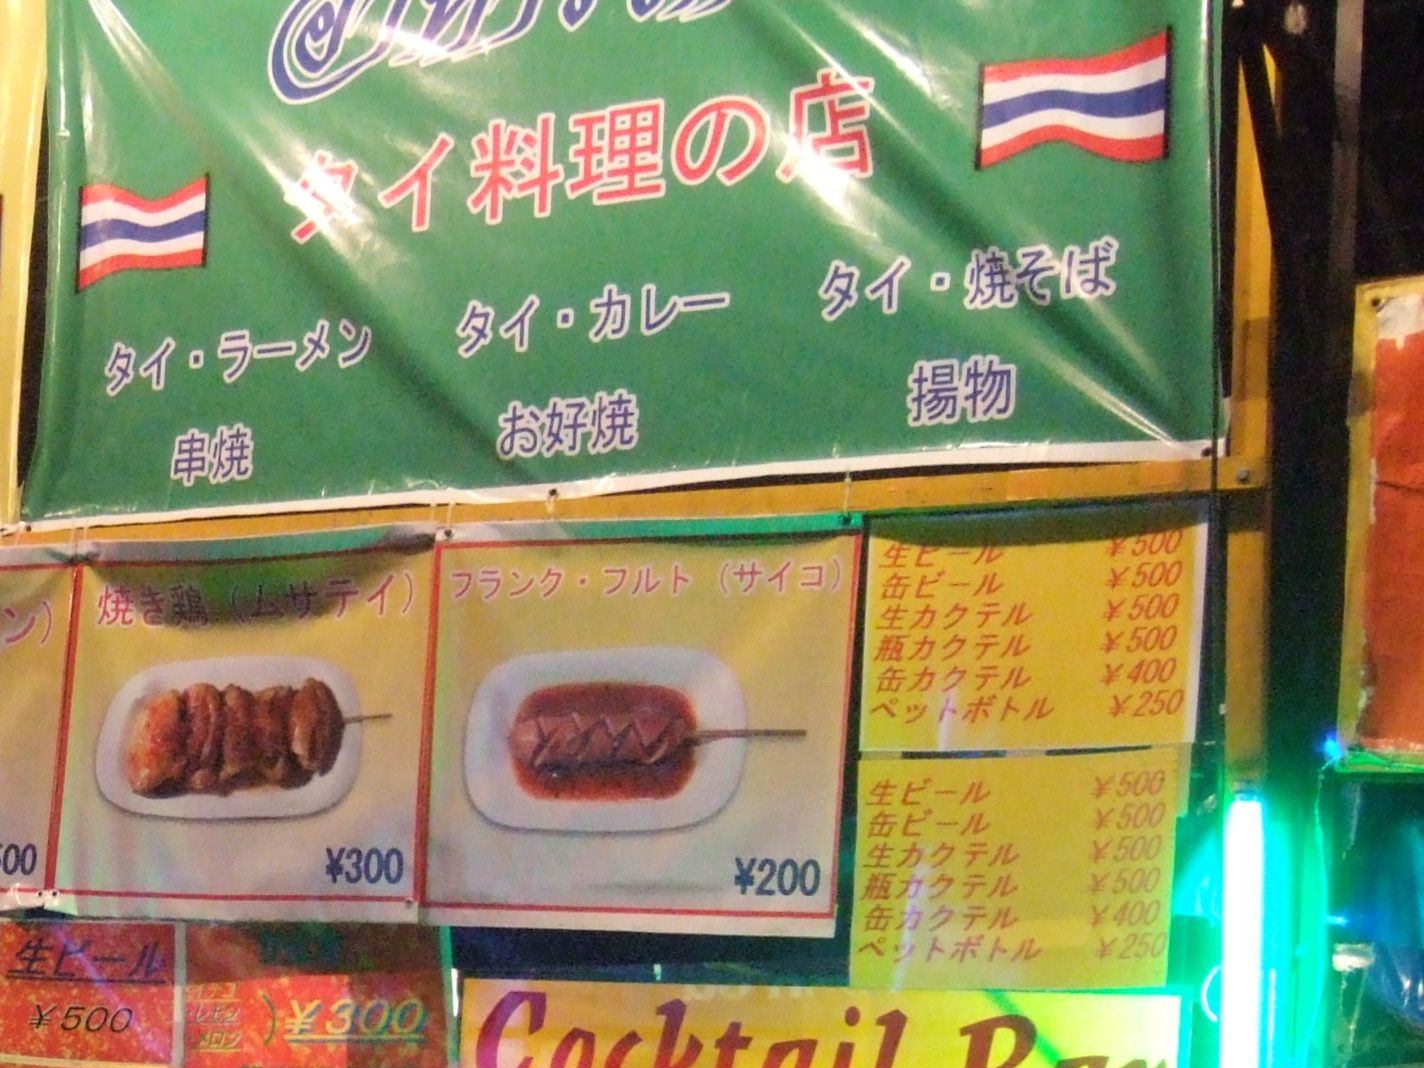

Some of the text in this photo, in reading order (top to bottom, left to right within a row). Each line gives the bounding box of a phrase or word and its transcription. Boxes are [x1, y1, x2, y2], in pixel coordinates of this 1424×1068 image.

[289, 67, 875, 243] タイ料理の店
[106, 235, 1118, 395] タイ・ラーメン タイ・カレー タイ・焼そば
[172, 356, 1017, 486] 串焼 お好焼 揚物
[881, 560, 1184, 600] 缶ビール ¥500
[876, 593, 1180, 631] 生カクテル ¥500
[873, 625, 1178, 662] 瓶カクテル ¥500
[876, 658, 1177, 693] 缶カクテル ¥400
[1108, 690, 1185, 718] ¥250
[865, 770, 1166, 806] 生ビール ¥500
[867, 803, 1166, 838] 缶ビール ¥500
[325, 847, 404, 885] ¥300
[863, 835, 1164, 869] 生カクテル ¥500
[734, 856, 821, 898] ¥200
[1088, 867, 1163, 896] ¥500
[11, 937, 166, 978] 生ビール
[28, 1004, 134, 1034] ¥500
[285, 996, 426, 1035] ¥300
